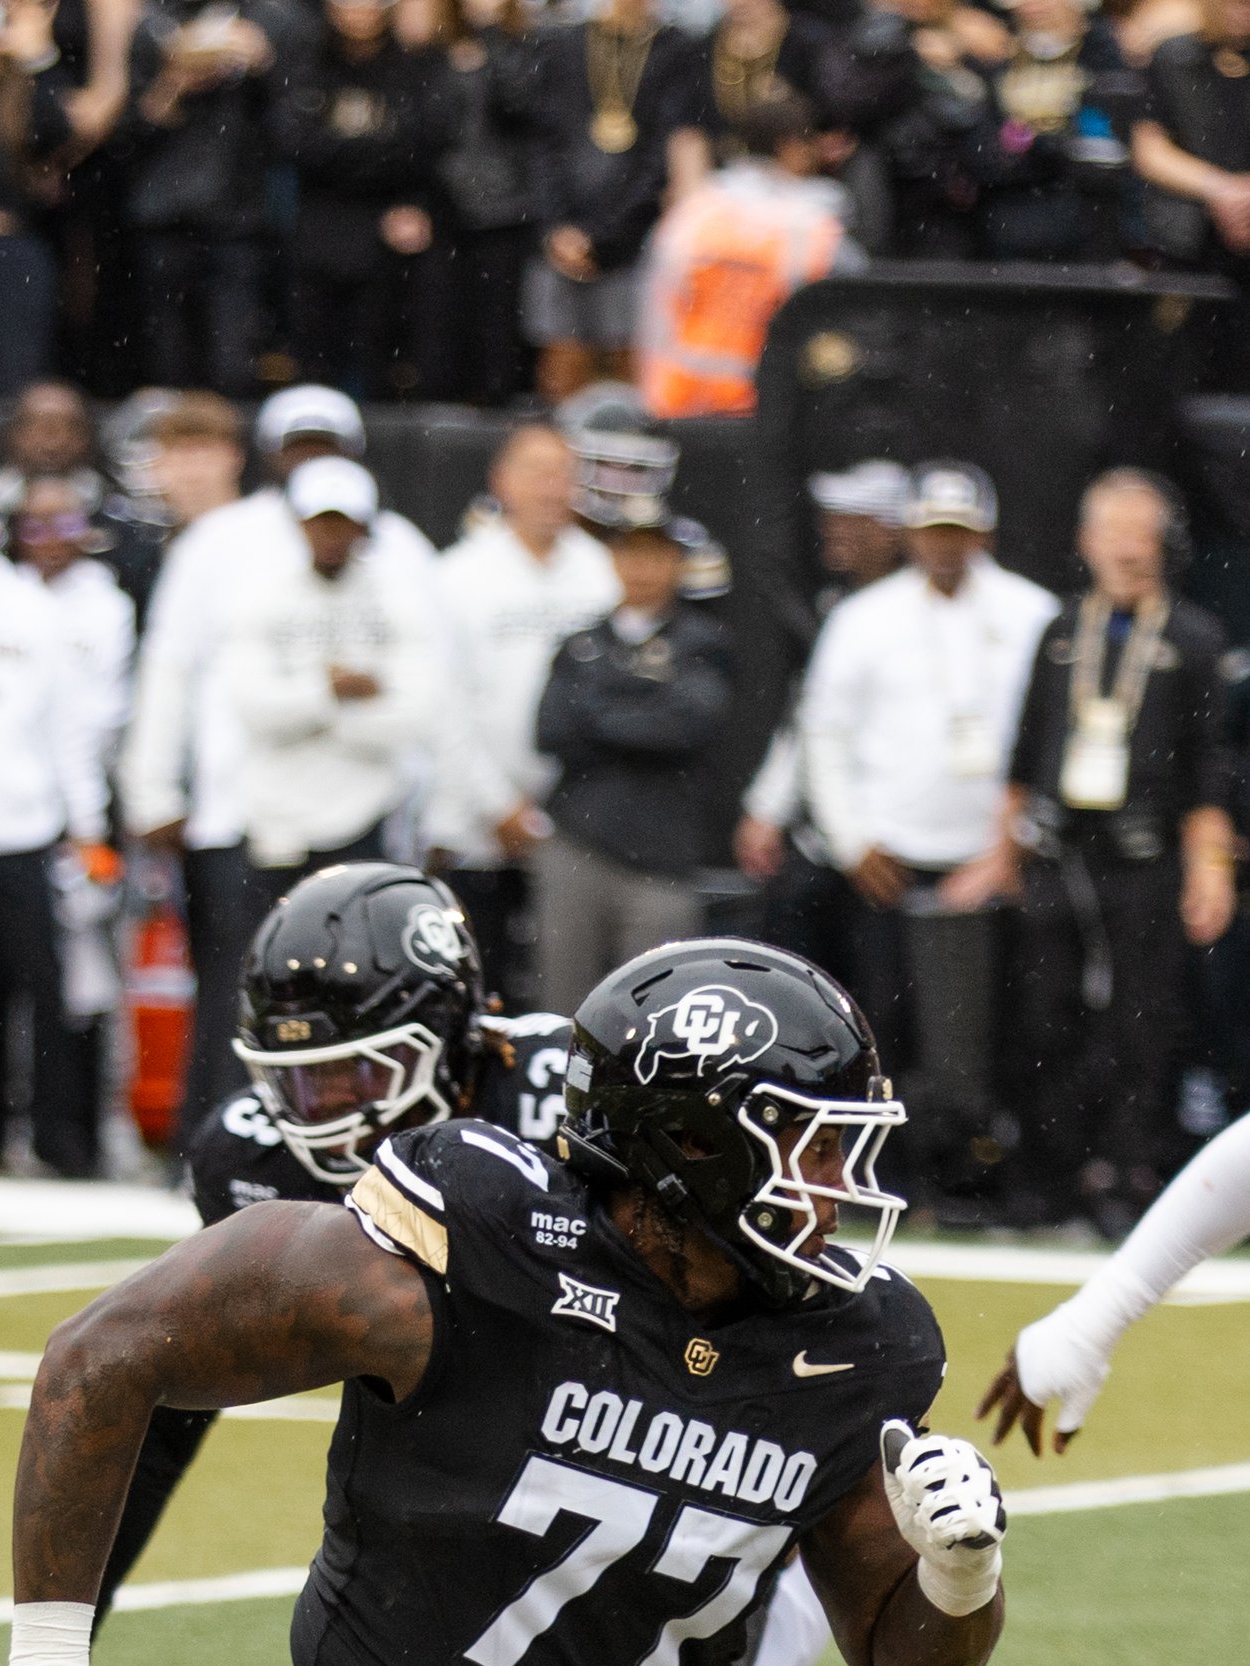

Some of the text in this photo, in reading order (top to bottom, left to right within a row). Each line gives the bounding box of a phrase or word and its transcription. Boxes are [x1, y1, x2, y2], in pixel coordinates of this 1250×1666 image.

[672, 995, 741, 1055] CU
[531, 1211, 587, 1236] mac
[535, 1230, 579, 1249] 82-94
[540, 1381, 818, 1512] COLORADO
